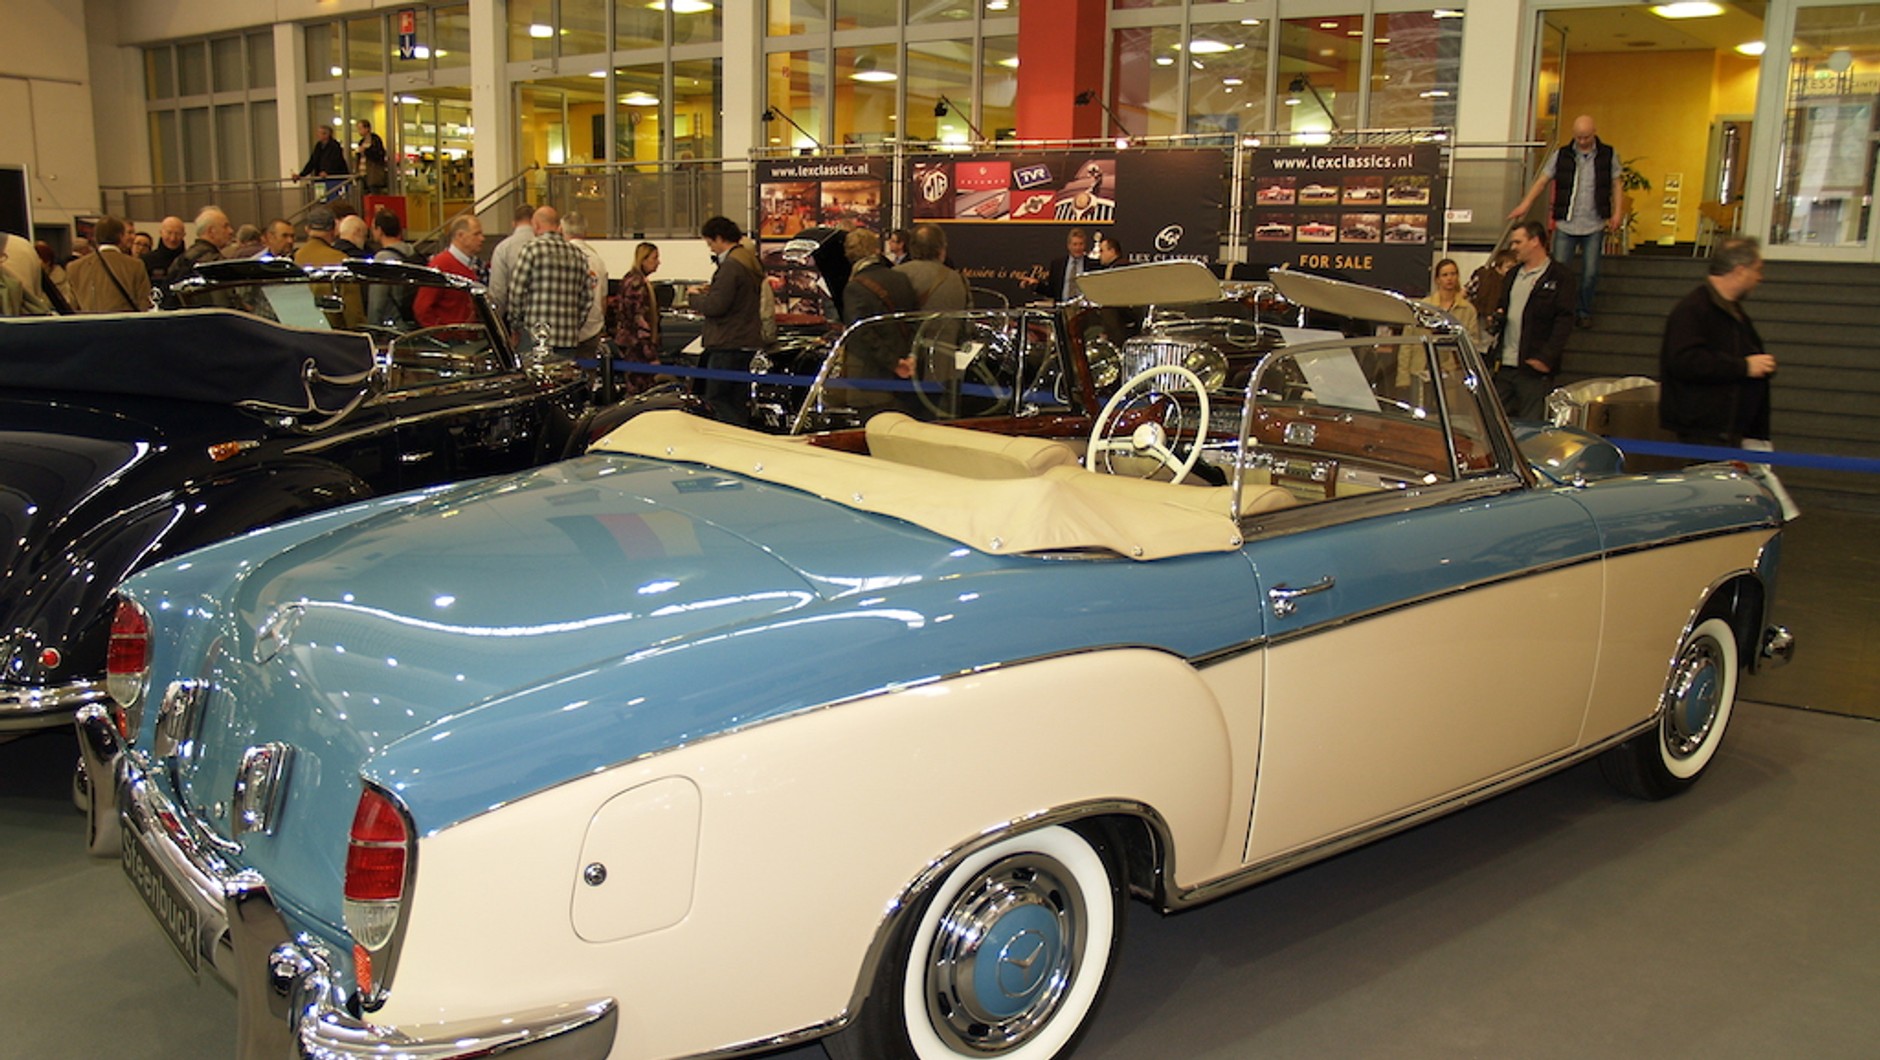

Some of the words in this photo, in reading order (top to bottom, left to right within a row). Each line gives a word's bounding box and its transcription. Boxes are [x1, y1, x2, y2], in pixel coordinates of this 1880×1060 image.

[1273, 154, 1413, 169] www.lexclassics.nl
[771, 163, 869, 177] www.lexclassics.nl
[1020, 168, 1046, 182] TVR
[924, 172, 947, 201] MG
[1129, 253, 1150, 262] LEX
[1300, 255, 1329, 269] FOR
[1335, 255, 1373, 270] SALE
[122, 829, 197, 957] Steenbuck
